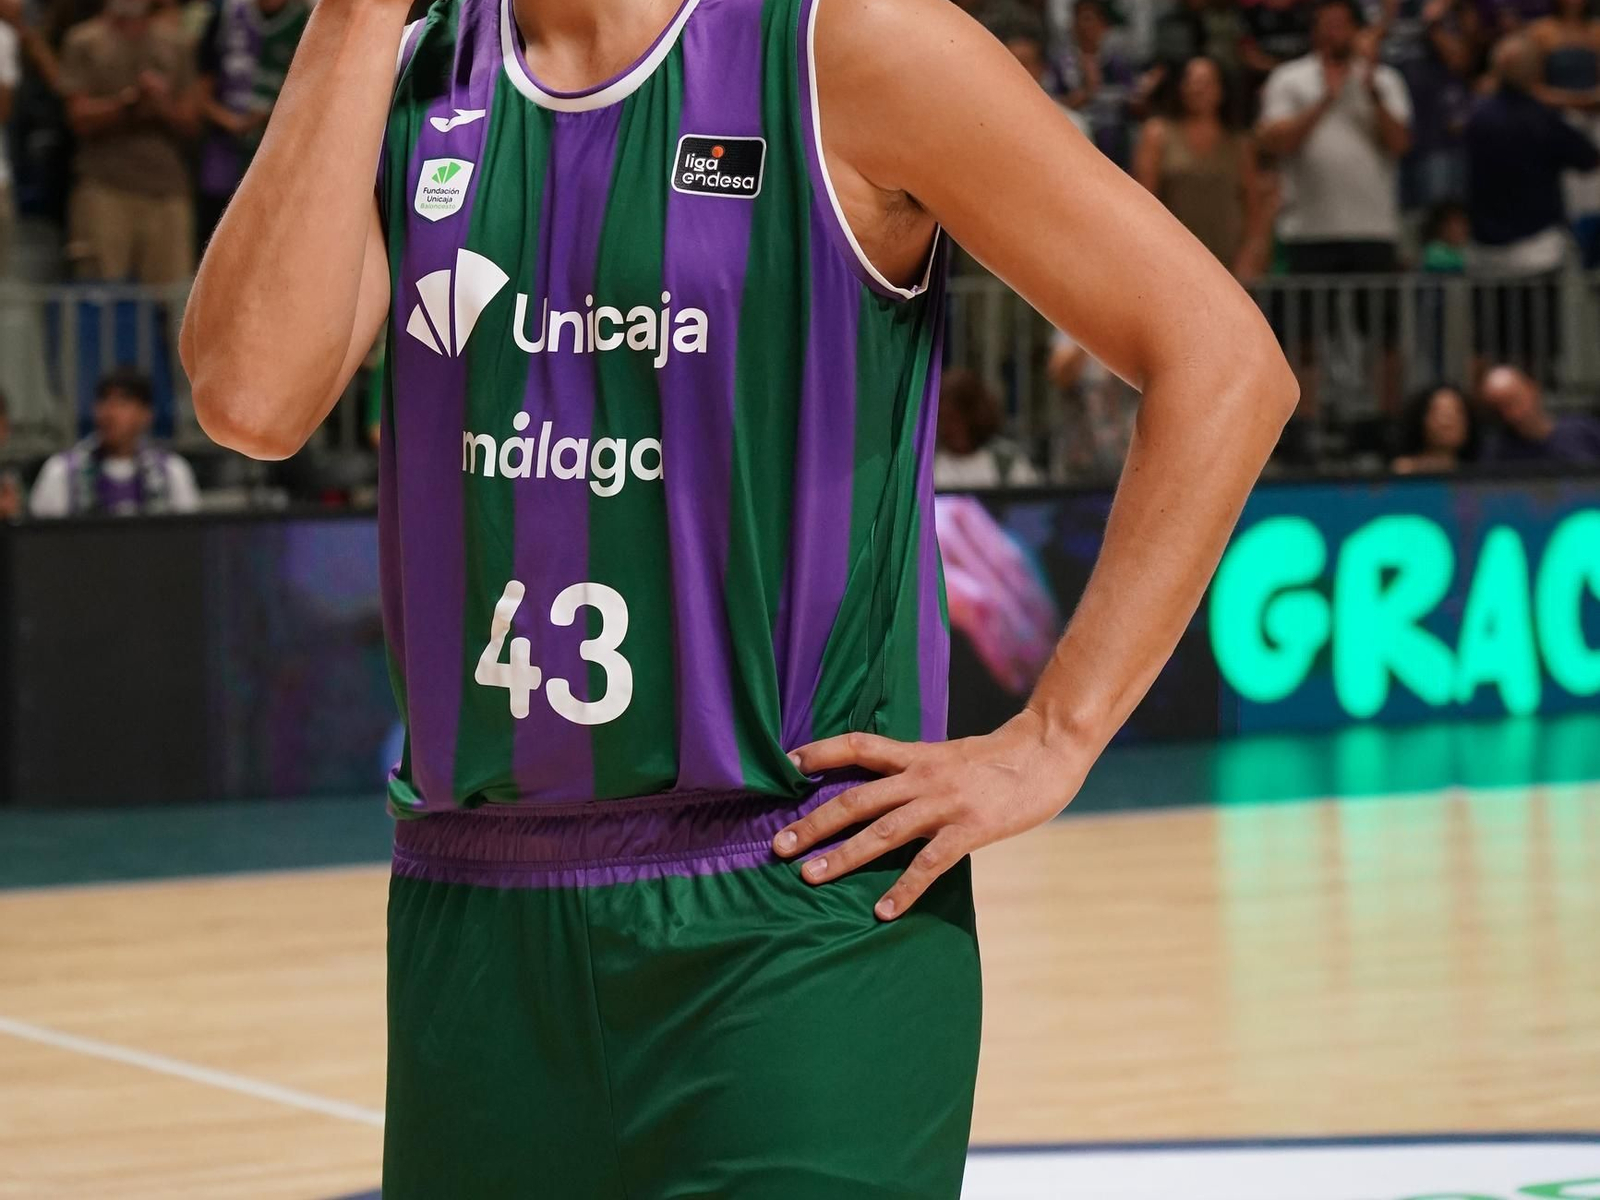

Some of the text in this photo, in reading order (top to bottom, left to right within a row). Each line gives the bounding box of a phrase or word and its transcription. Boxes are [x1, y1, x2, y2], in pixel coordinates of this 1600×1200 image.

[682, 171, 755, 189] endesa
[685, 152, 719, 172] liga
[423, 187, 459, 195] Fundación
[426, 195, 453, 204] Unicaja
[513, 290, 709, 369] Unicaja
[461, 411, 664, 497] málaga
[1209, 509, 1600, 719] GRAC
[474, 580, 634, 726] 43
